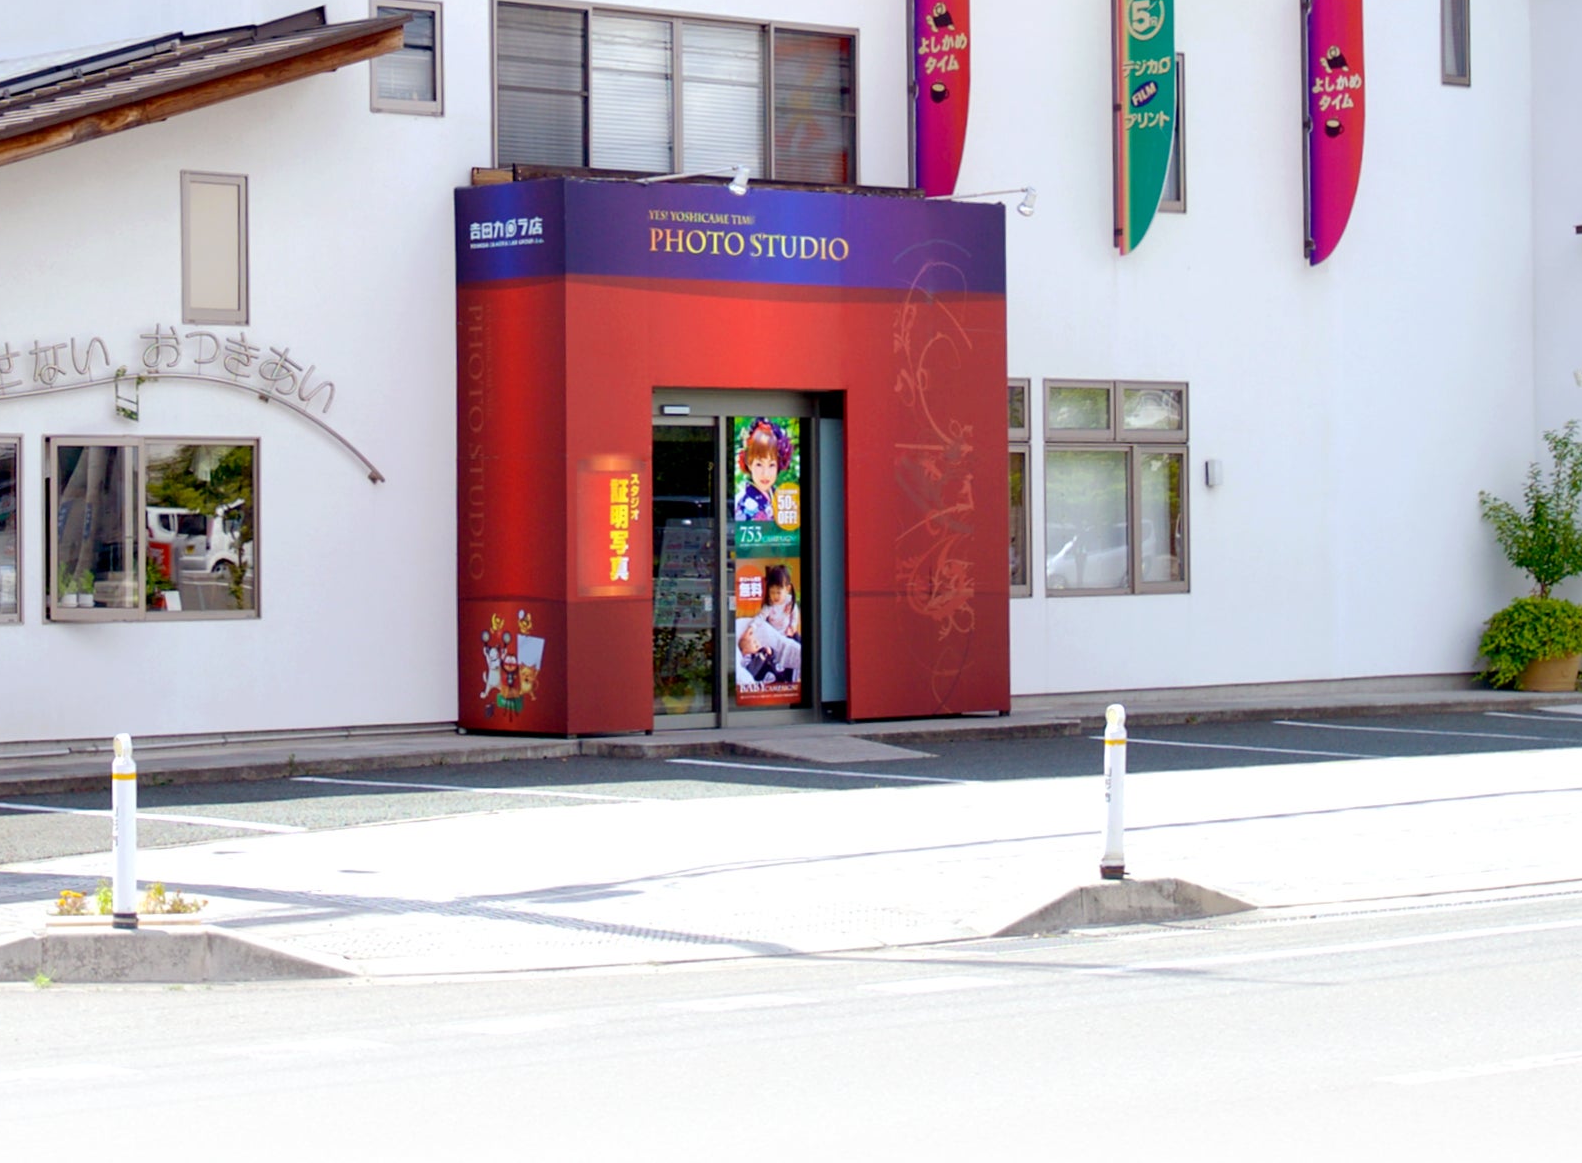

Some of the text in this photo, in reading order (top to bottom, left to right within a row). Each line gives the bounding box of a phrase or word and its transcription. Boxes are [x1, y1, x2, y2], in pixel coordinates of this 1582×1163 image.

[918, 33, 968, 55] よしかめ
[925, 54, 960, 75] タイム
[1132, 81, 1157, 107] FILM
[1312, 73, 1363, 94] よしかめ
[1319, 92, 1355, 112] タイム
[1123, 110, 1170, 131] プリント
[670, 210, 729, 225] YOSHICAME
[649, 227, 850, 262] PHOTO STUDIO
[140, 323, 335, 414] おつきあい
[468, 306, 485, 581] PHOTO STUDIO
[630, 473, 640, 521] スタジオ
[609, 478, 629, 582] 証明写真
[739, 525, 763, 543] 753
